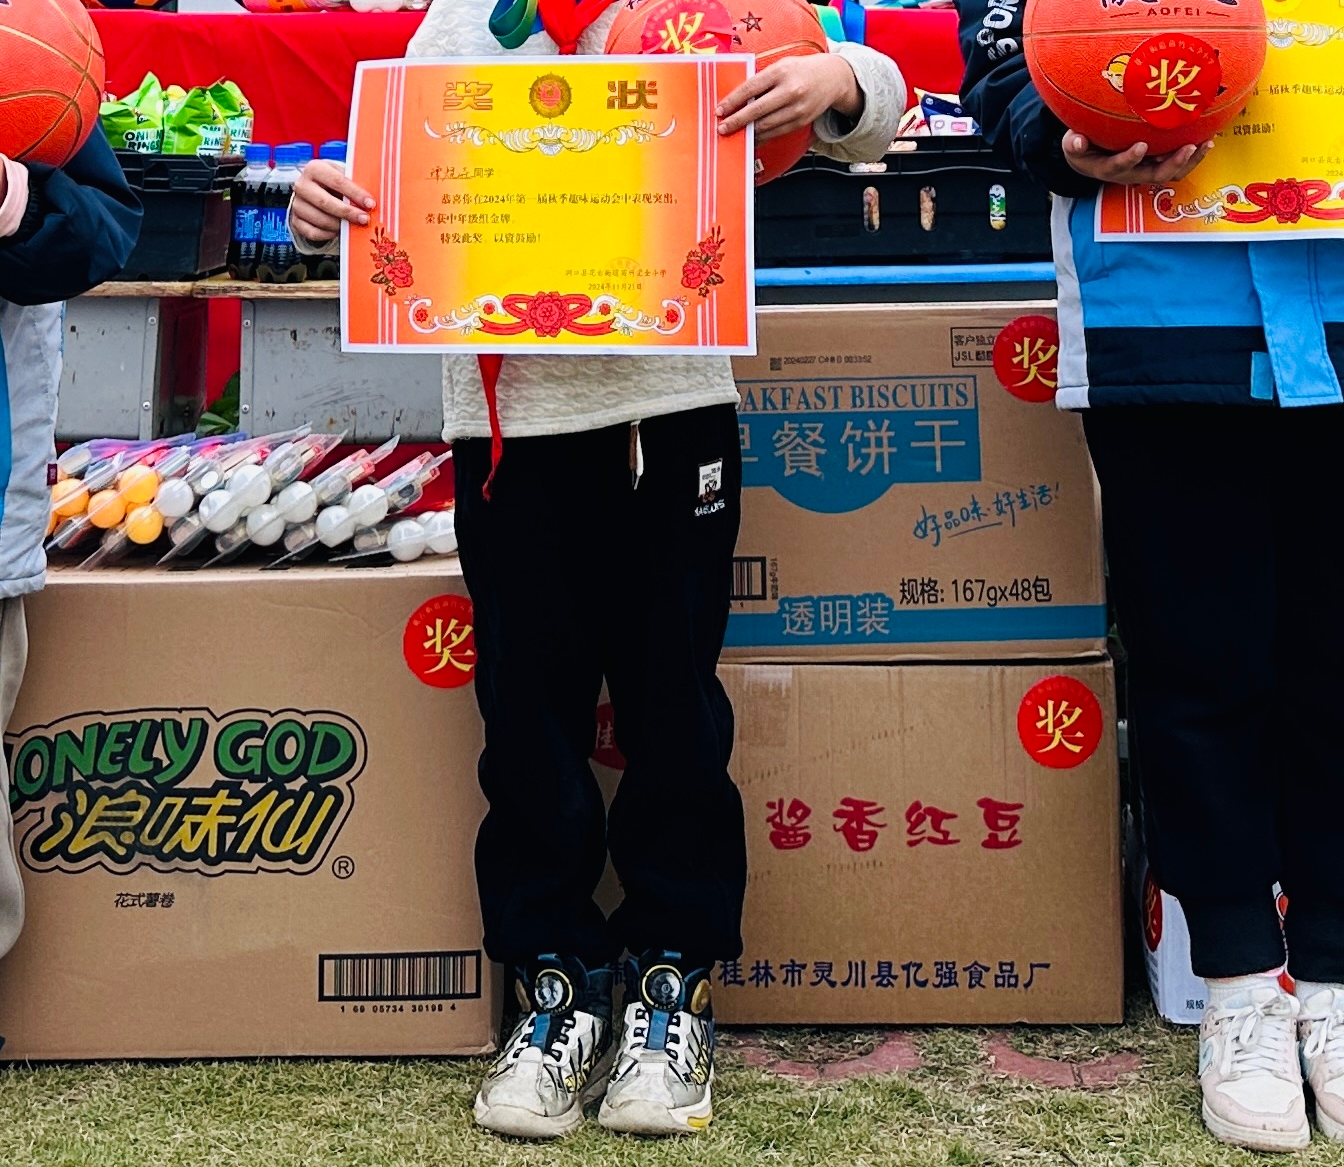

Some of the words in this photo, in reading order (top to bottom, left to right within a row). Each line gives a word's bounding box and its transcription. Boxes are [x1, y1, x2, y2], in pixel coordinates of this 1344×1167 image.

[658, 12, 719, 55] 奖
[1146, 7, 1201, 17] AOFEI
[1144, 58, 1203, 113] 奖
[1011, 336, 1058, 389] 奖
[736, 385, 843, 412] AKFAST
[850, 382, 970, 409] BISCUITS
[781, 598, 891, 636] 透明装
[422, 617, 474, 674] 奖
[212, 718, 355, 783] GOD
[1034, 699, 1086, 754] 奖
[36, 788, 336, 859] 浪味仙
[764, 796, 1027, 854] 酱香红豆
[717, 958, 1052, 991] 桂林市灵川县亿强食品厂
[1185, 998, 1205, 1010] 规格
